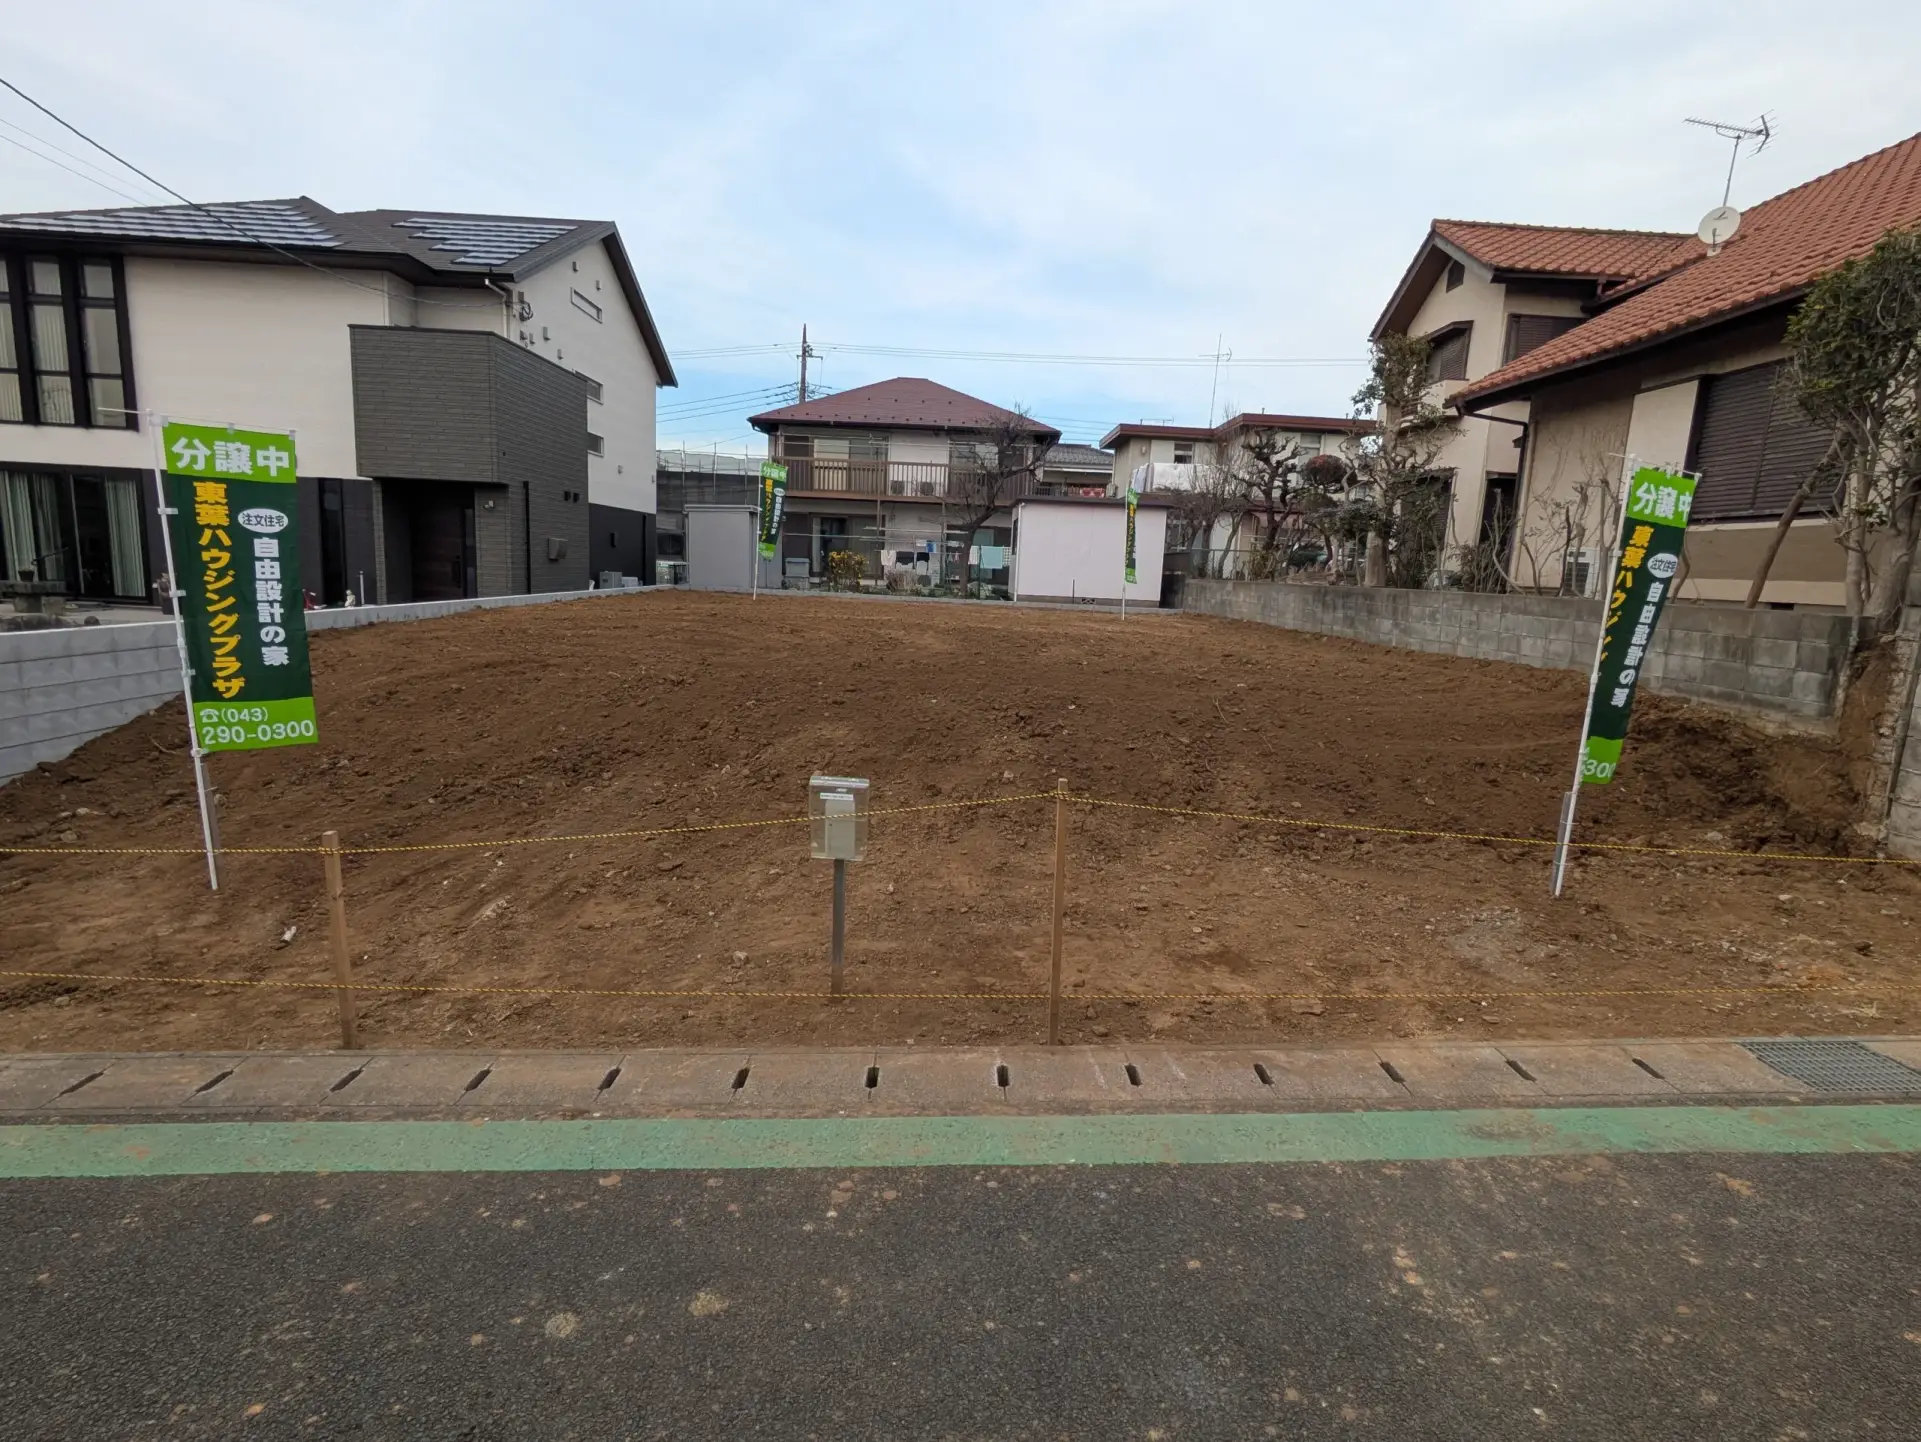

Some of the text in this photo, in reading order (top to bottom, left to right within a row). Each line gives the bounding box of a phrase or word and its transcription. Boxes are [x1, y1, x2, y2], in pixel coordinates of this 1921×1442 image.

[171, 437, 289, 477] 分譲中
[241, 512, 285, 529] 注文住宅
[1633, 482, 1692, 522] 分譲中
[192, 481, 245, 699] 東葉ハウジングプラザ
[253, 537, 290, 666] 自由設計の家
[202, 719, 315, 745] 290-0300
[220, 707, 268, 723] (043)
